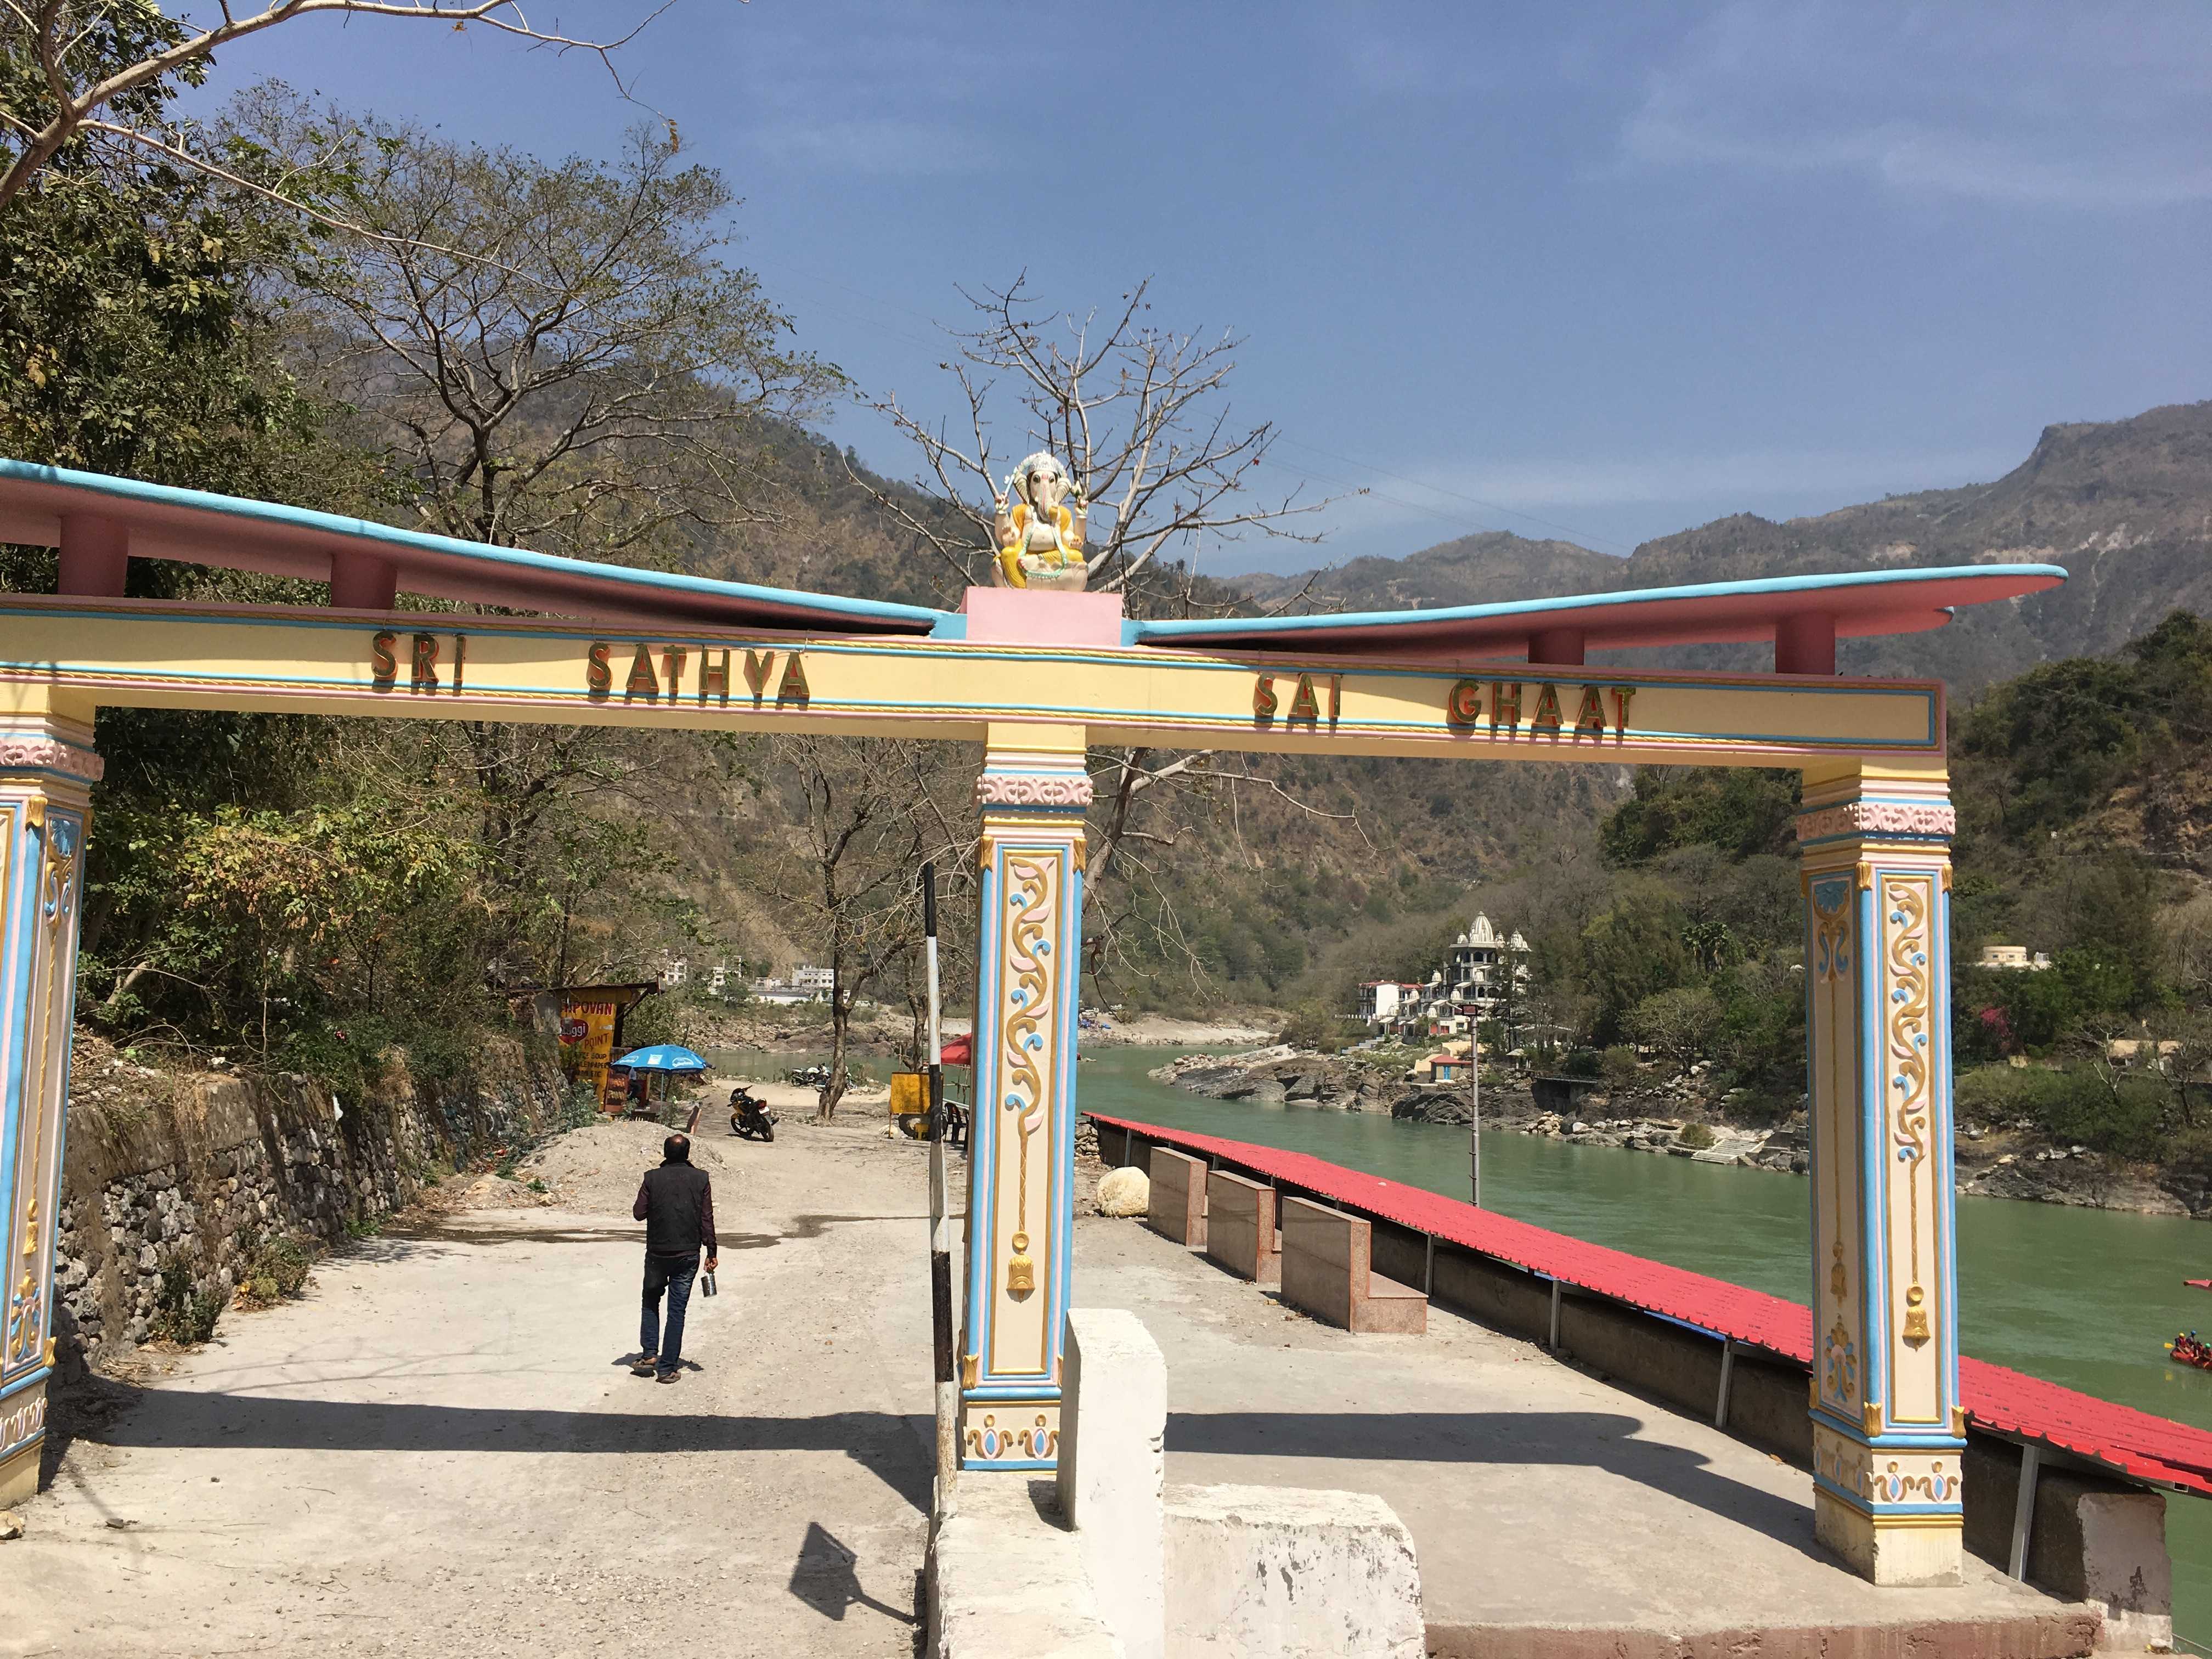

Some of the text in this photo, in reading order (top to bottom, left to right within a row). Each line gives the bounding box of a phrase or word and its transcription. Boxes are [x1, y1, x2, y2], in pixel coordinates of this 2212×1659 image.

[371, 630, 1637, 730] SRI SATHYA SAI GHAAT
[584, 1033, 610, 1050] POINT
